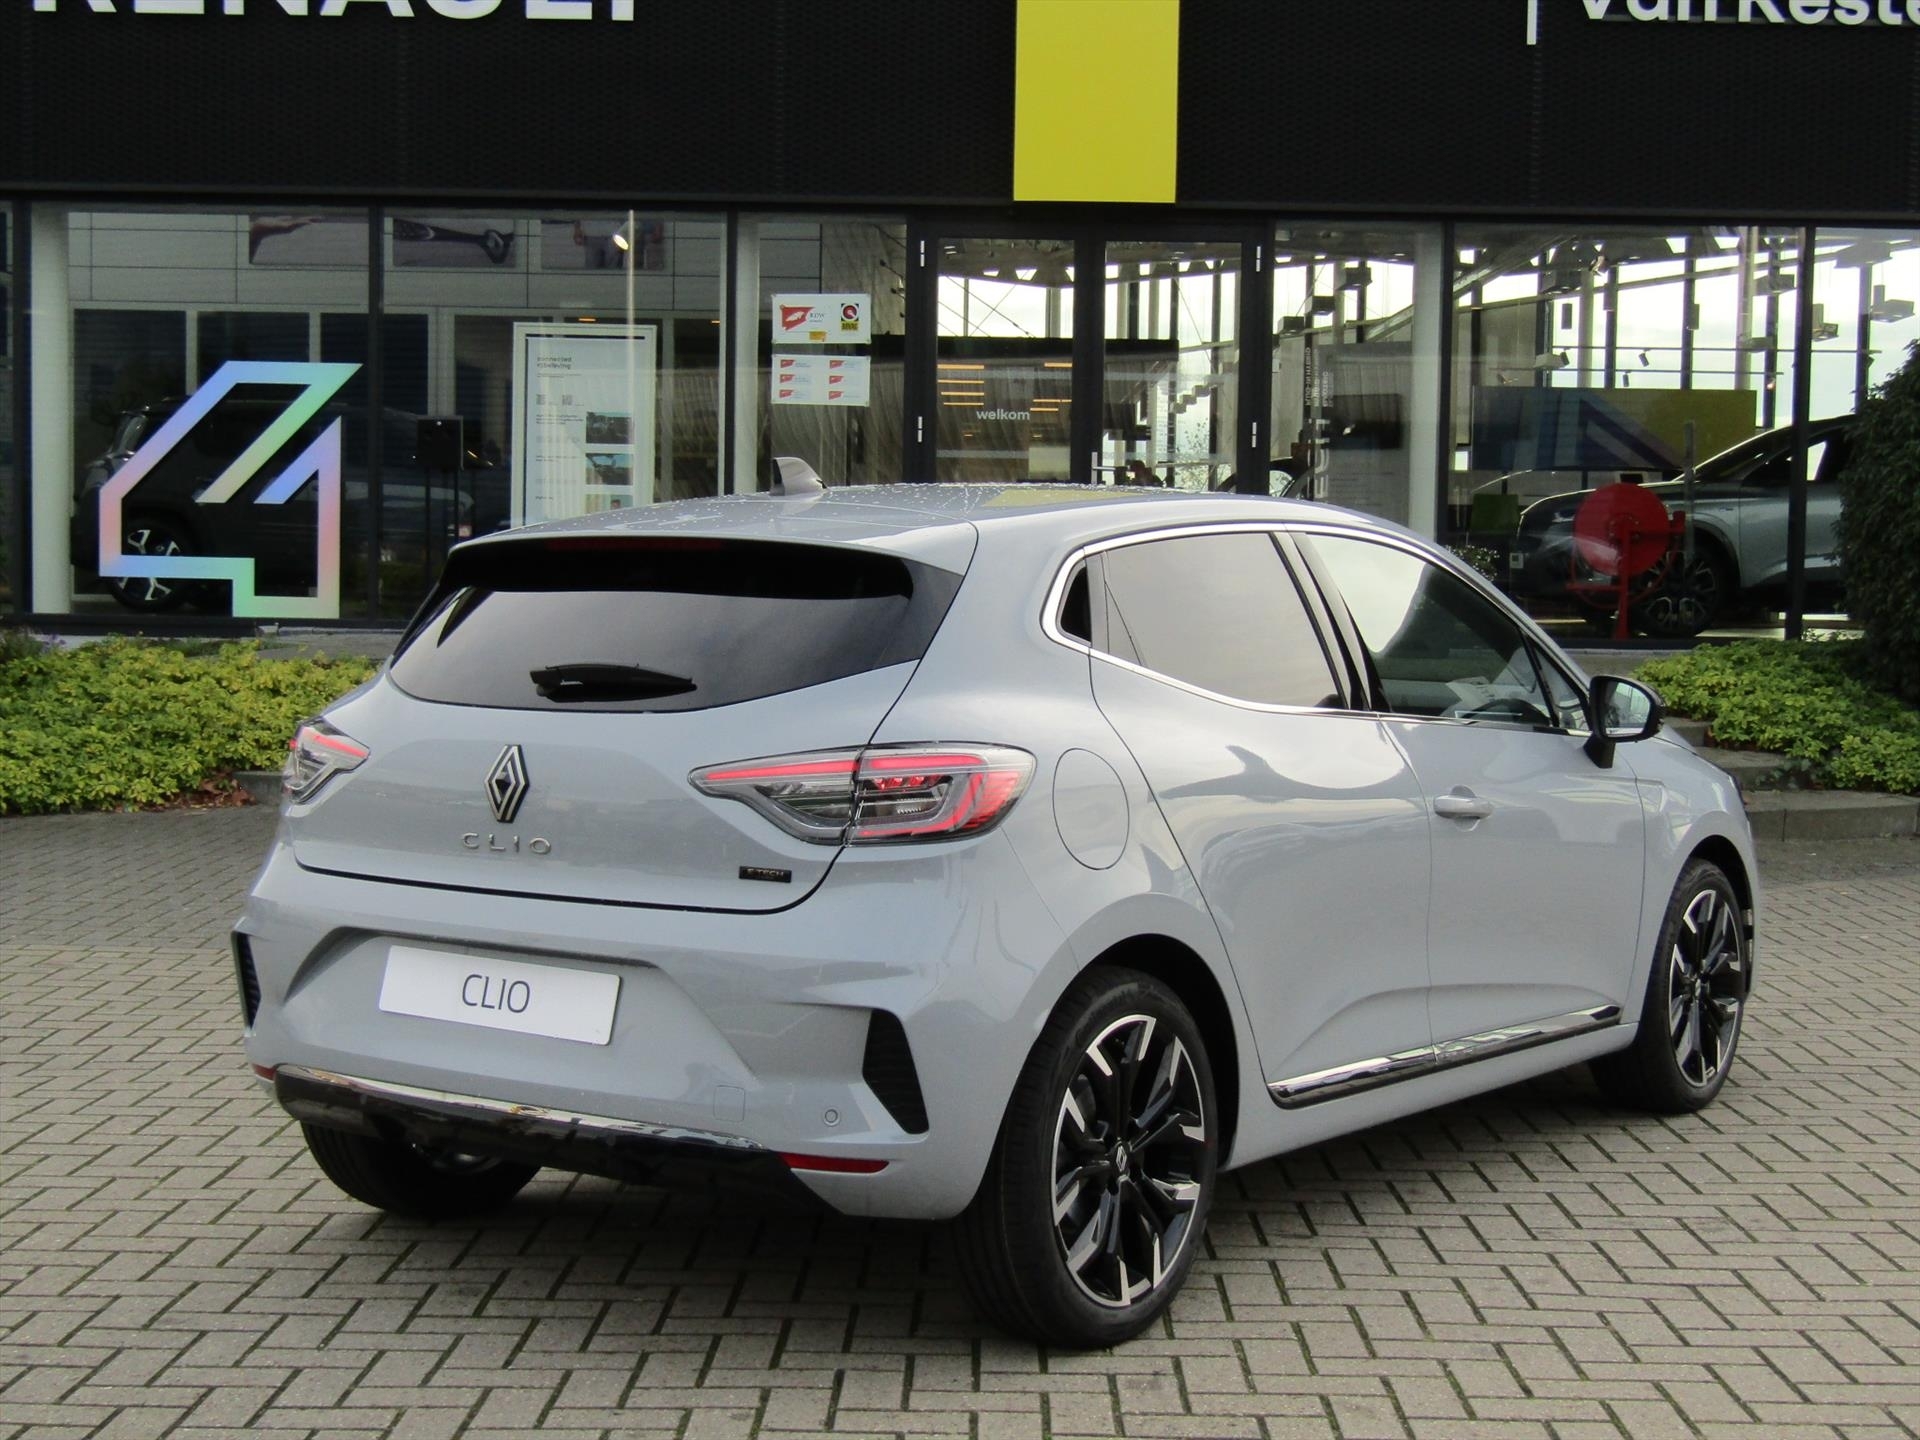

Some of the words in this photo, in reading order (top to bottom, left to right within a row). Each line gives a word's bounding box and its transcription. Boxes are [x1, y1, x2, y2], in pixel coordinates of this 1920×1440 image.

[976, 408, 1031, 421] welkom
[463, 832, 551, 855] CLIO
[462, 973, 530, 1013] CLIO
